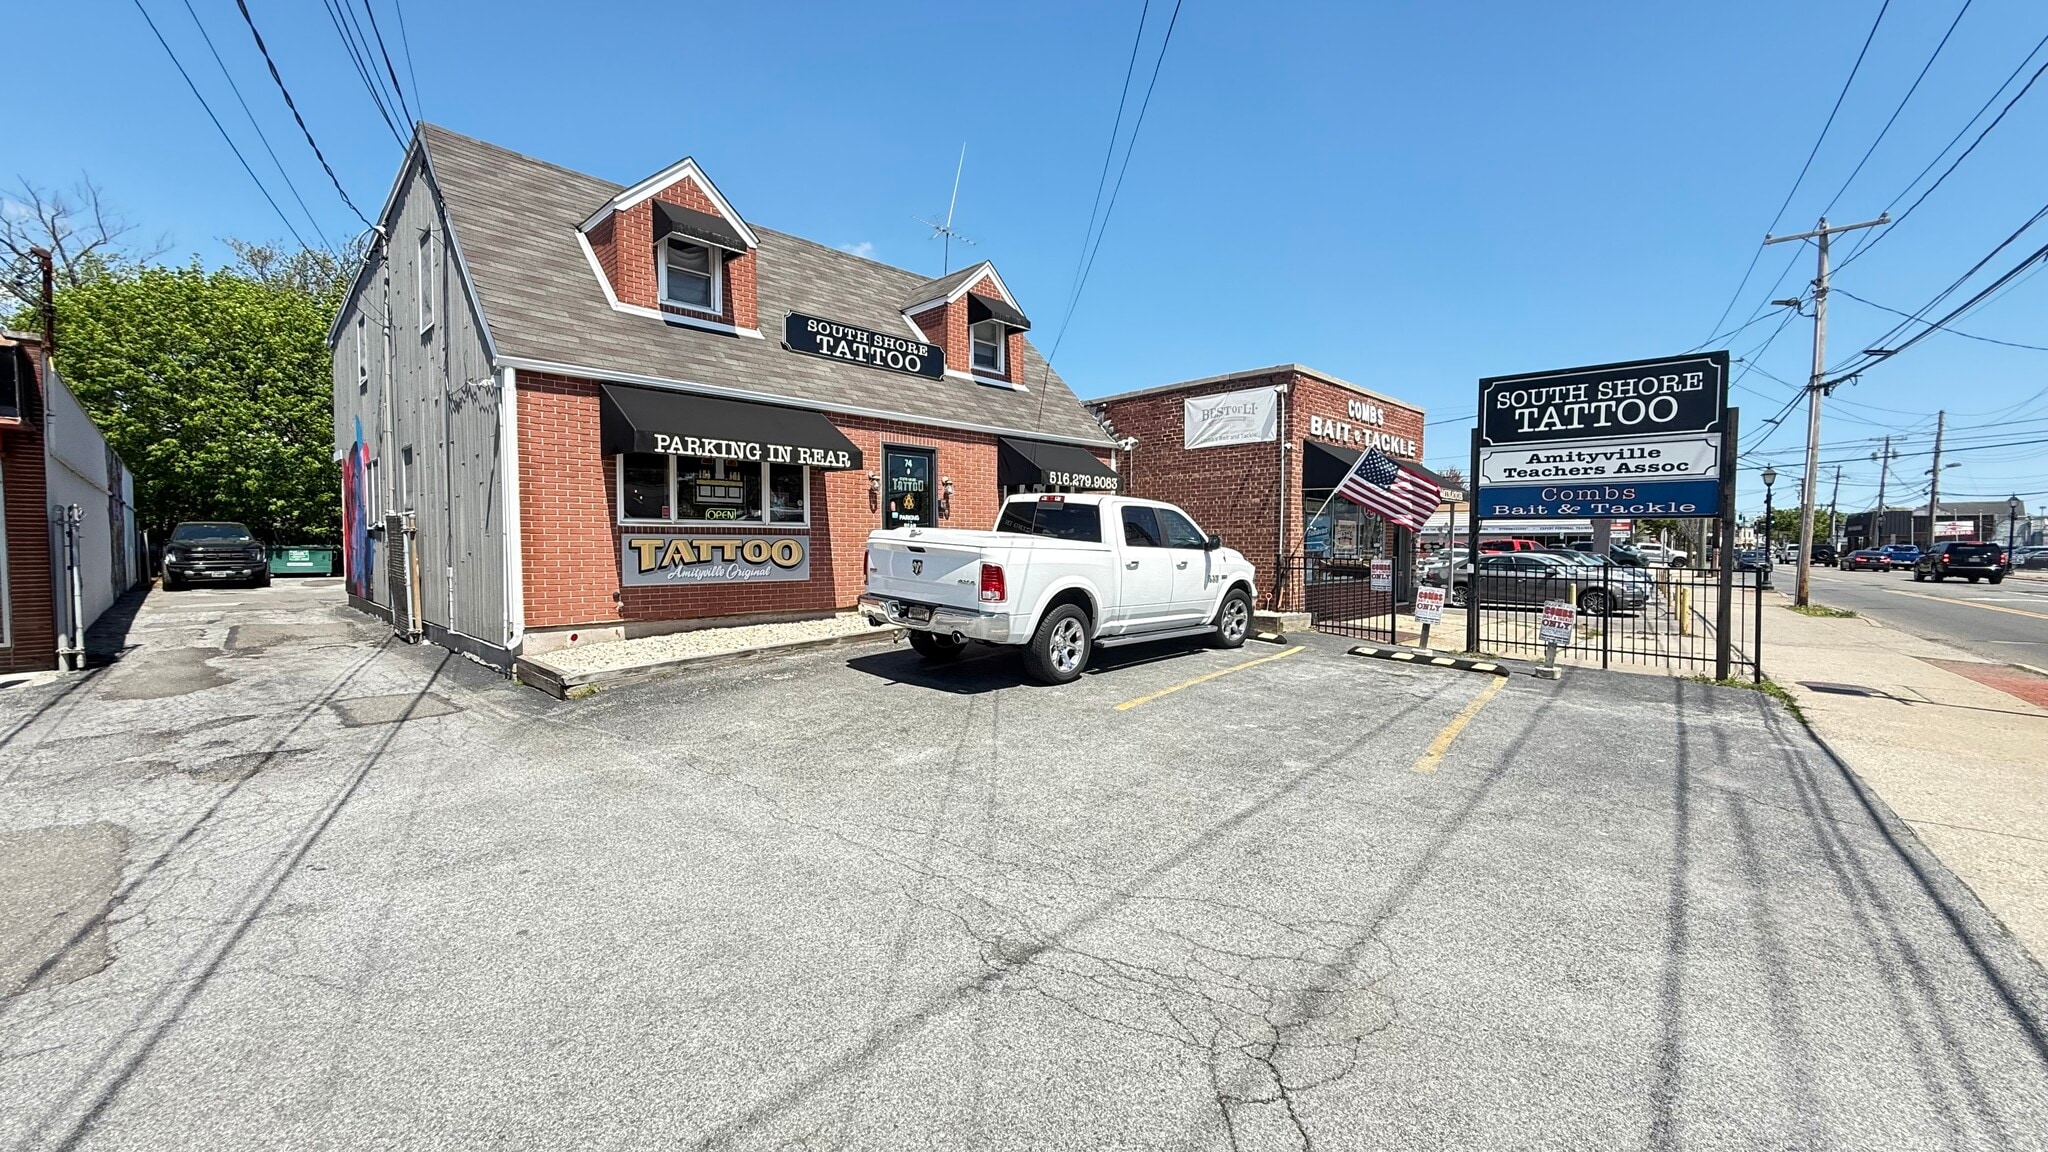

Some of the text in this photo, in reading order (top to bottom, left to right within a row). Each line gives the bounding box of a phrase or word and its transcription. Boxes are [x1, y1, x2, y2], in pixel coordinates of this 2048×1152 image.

[807, 319, 928, 357] SOUTH SHORE
[816, 335, 921, 373] TATTOO
[1497, 372, 1703, 409] SOUTH SHORE
[1201, 406, 1232, 422] BEST
[1348, 399, 1384, 426] COMBS
[1515, 395, 1678, 433] TATTOO
[1310, 415, 1351, 442] BAIT
[1362, 428, 1416, 457] TACKLE
[654, 434, 851, 468] PARKING IN REAR
[1526, 447, 1661, 465] Amityville
[904, 459, 913, 468] 74
[1504, 462, 1690, 479] Teachers Assoc
[1049, 471, 1118, 490] 516.279.9083
[1541, 486, 1636, 501] Combs
[707, 510, 735, 520] OPEN
[1493, 502, 1696, 515] Bait & Tackle
[629, 538, 804, 574] TATTOO
[667, 563, 772, 580] Amityville Original
[1417, 603, 1441, 612] ONLY
[1542, 619, 1572, 630] ONLY
